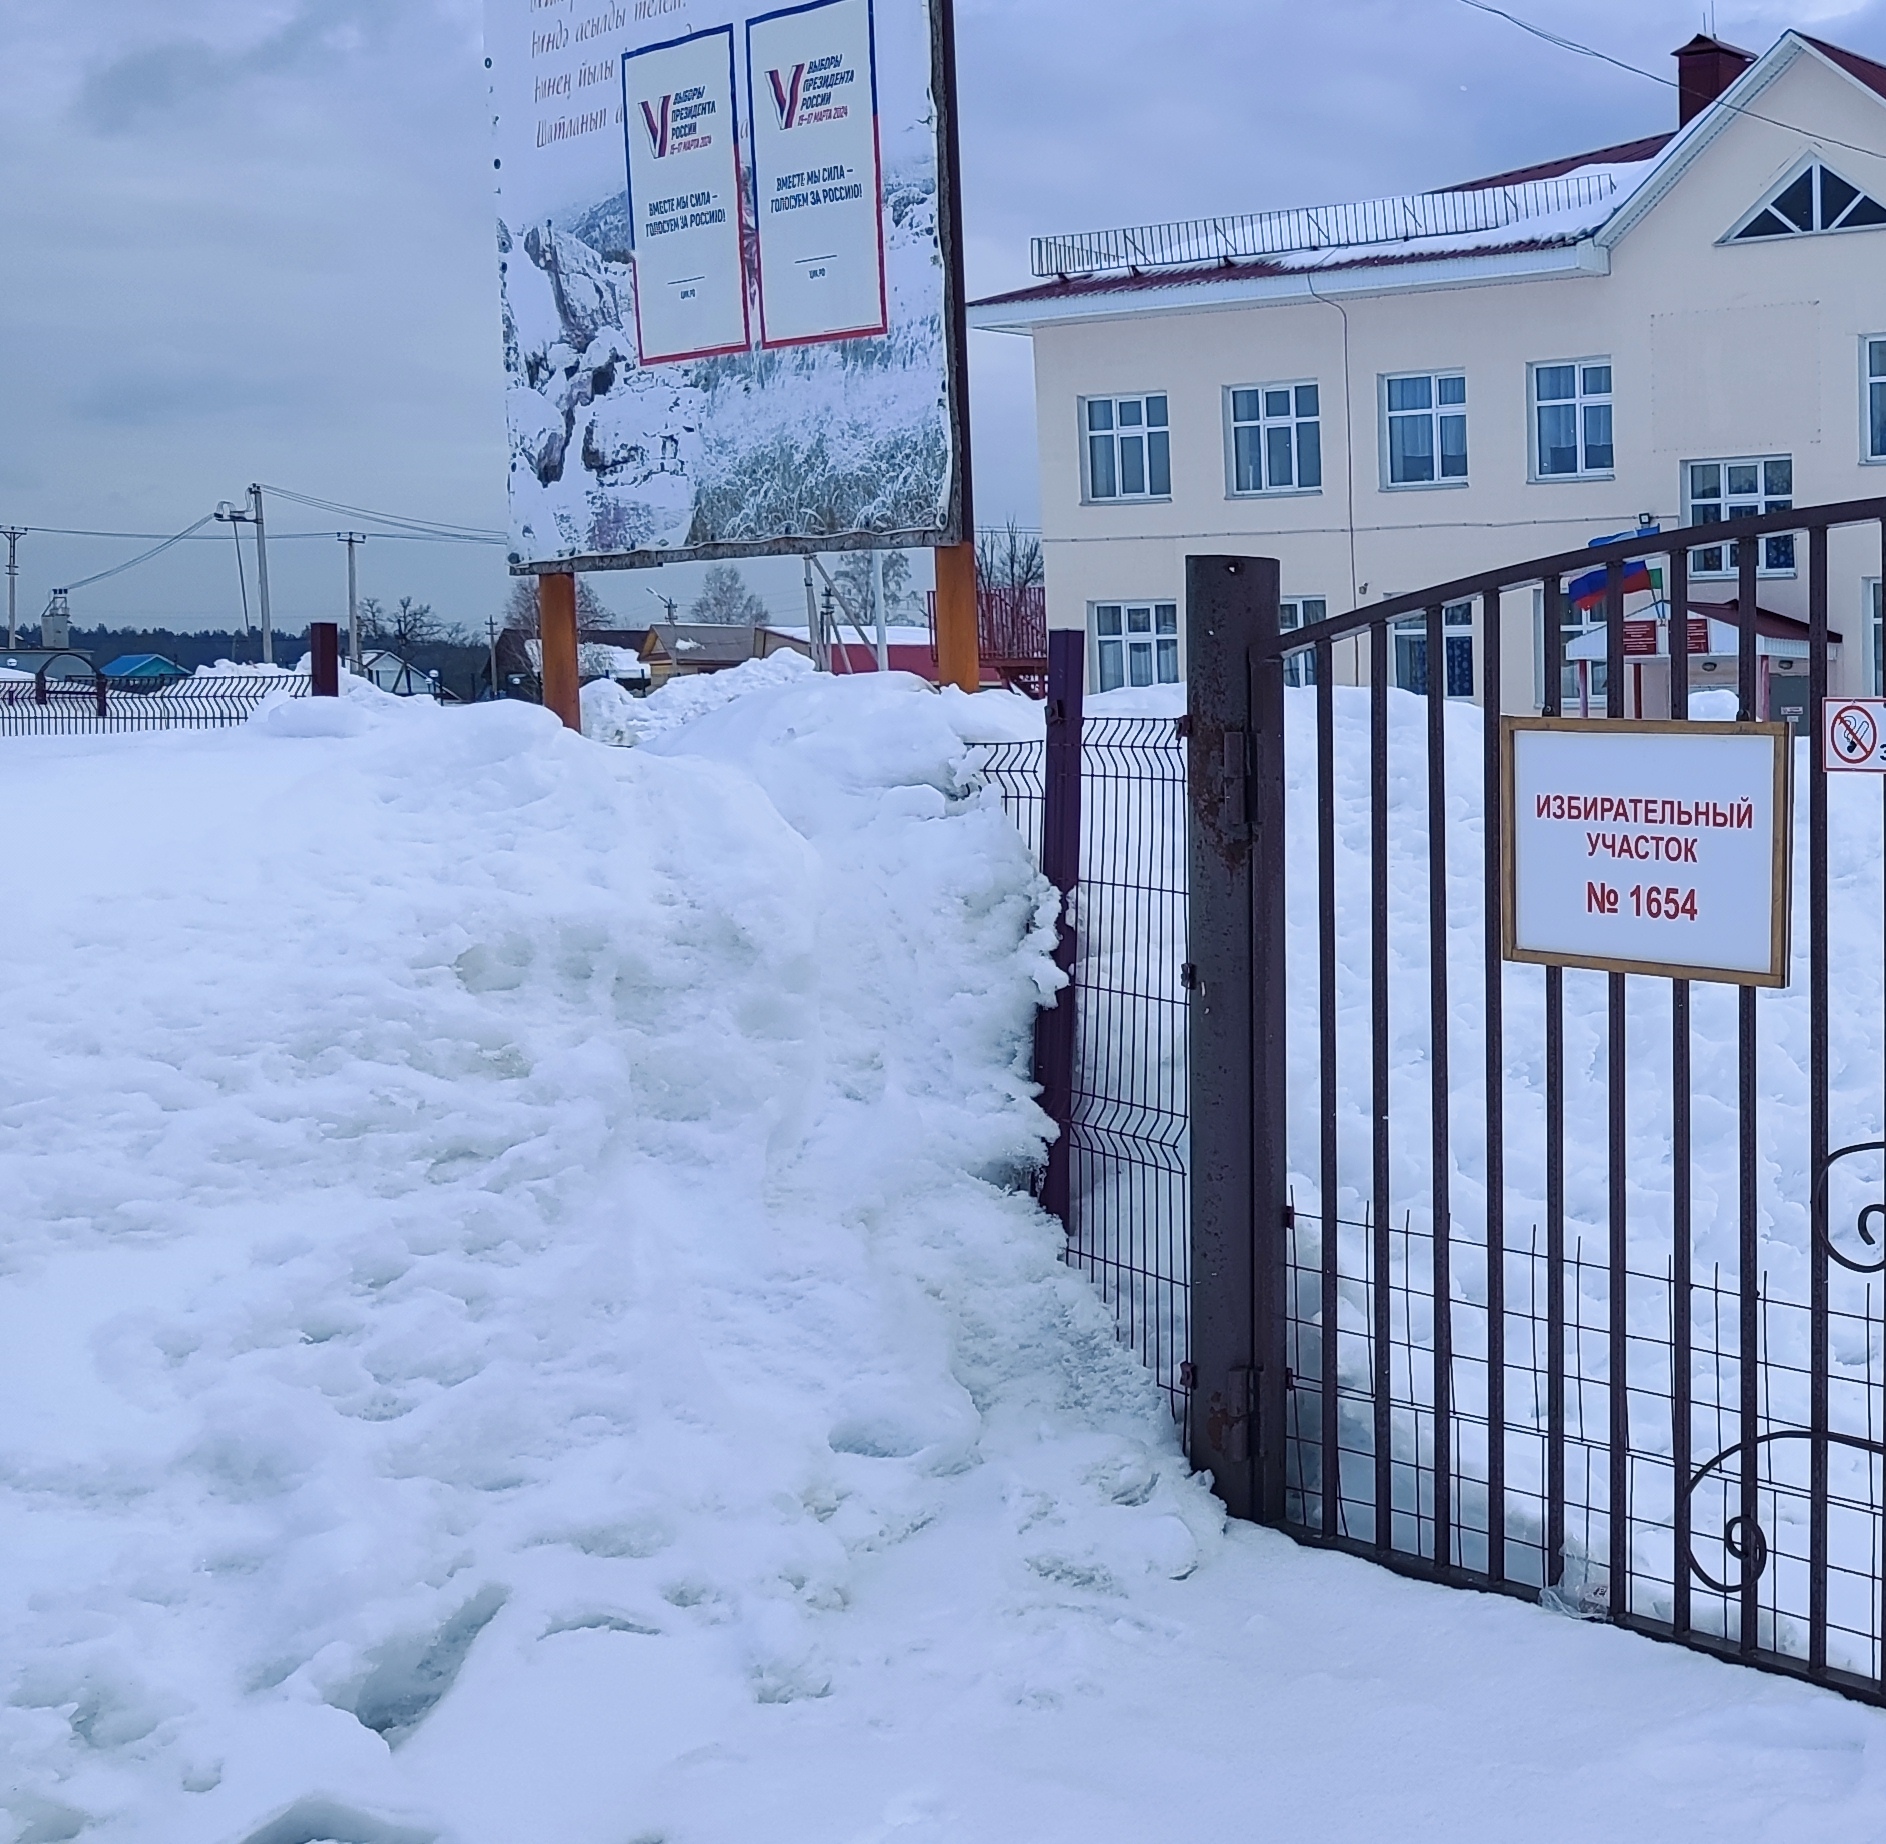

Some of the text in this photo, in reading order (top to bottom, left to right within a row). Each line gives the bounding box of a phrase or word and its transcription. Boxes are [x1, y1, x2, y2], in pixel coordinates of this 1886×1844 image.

[807, 53, 843, 74] ВЫБОРЫ
[803, 69, 855, 92] ПРЕЗИДЕНТА
[673, 85, 706, 105] ВЫБОРЫ
[800, 91, 832, 111] РОССИИ
[671, 100, 717, 123] ПРЕЗИДЕНТА
[833, 105, 848, 119] 2024
[671, 121, 697, 141] РОССИИ
[776, 172, 806, 192] ВМЕСТЕ
[806, 169, 821, 186] МЫ
[822, 164, 846, 182] СИЛА
[648, 197, 676, 217] ВМЕСТЕ
[675, 194, 689, 211] МЫ
[690, 190, 711, 208] СИЛА
[770, 182, 863, 214] ГОЛОСУЕМ ЗА РОССИЮ!
[645, 207, 727, 238] ГОЛОСУЕМ ЗА РОССИЮ!
[1535, 793, 1754, 830] ИЗБИРАТЕЛЬНЫЙ
[1586, 832, 1699, 864] УЧАСТОК
[1586, 881, 1699, 922] № 1654
